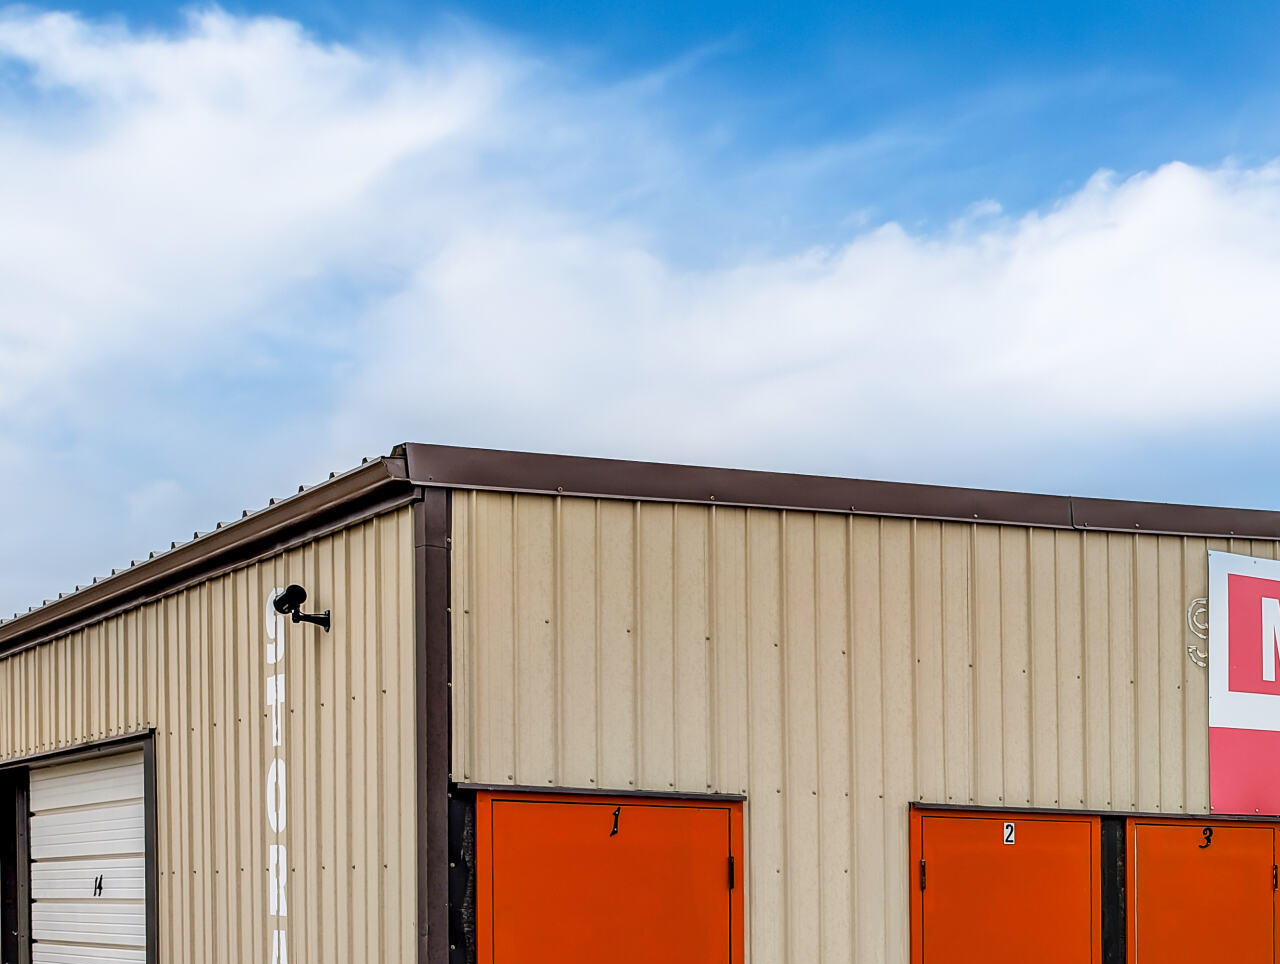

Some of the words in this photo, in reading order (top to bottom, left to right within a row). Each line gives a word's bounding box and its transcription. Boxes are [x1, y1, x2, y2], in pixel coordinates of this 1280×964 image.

[610, 806, 621, 837] 1
[1004, 823, 1015, 843] 2
[1198, 827, 1214, 849] 3
[93, 874, 104, 897] 14
